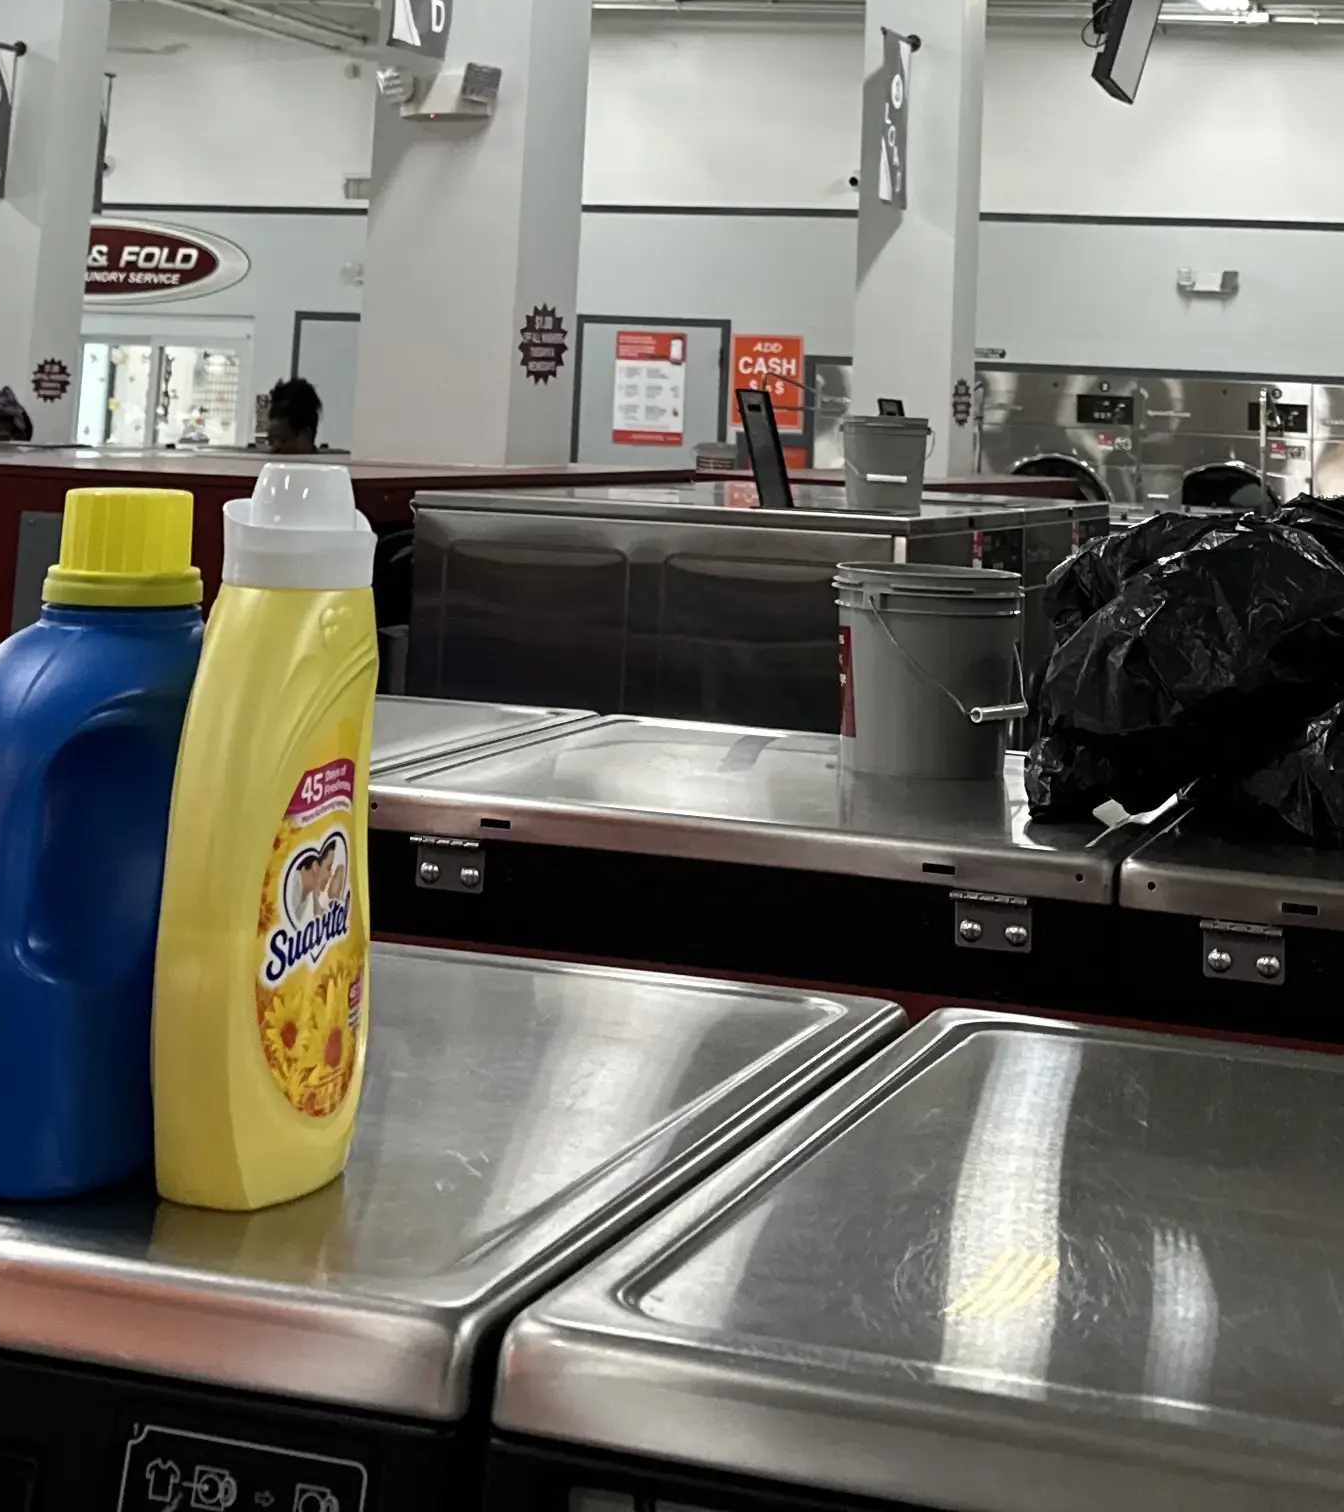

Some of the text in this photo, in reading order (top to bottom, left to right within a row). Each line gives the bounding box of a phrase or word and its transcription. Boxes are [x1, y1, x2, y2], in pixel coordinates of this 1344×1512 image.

[87, 245, 199, 269] & FOLD
[127, 272, 182, 285] SERVICE
[752, 341, 784, 354] ADD
[737, 355, 797, 377] CASH
[300, 772, 324, 805] 45
[265, 890, 351, 982] Suavitel
